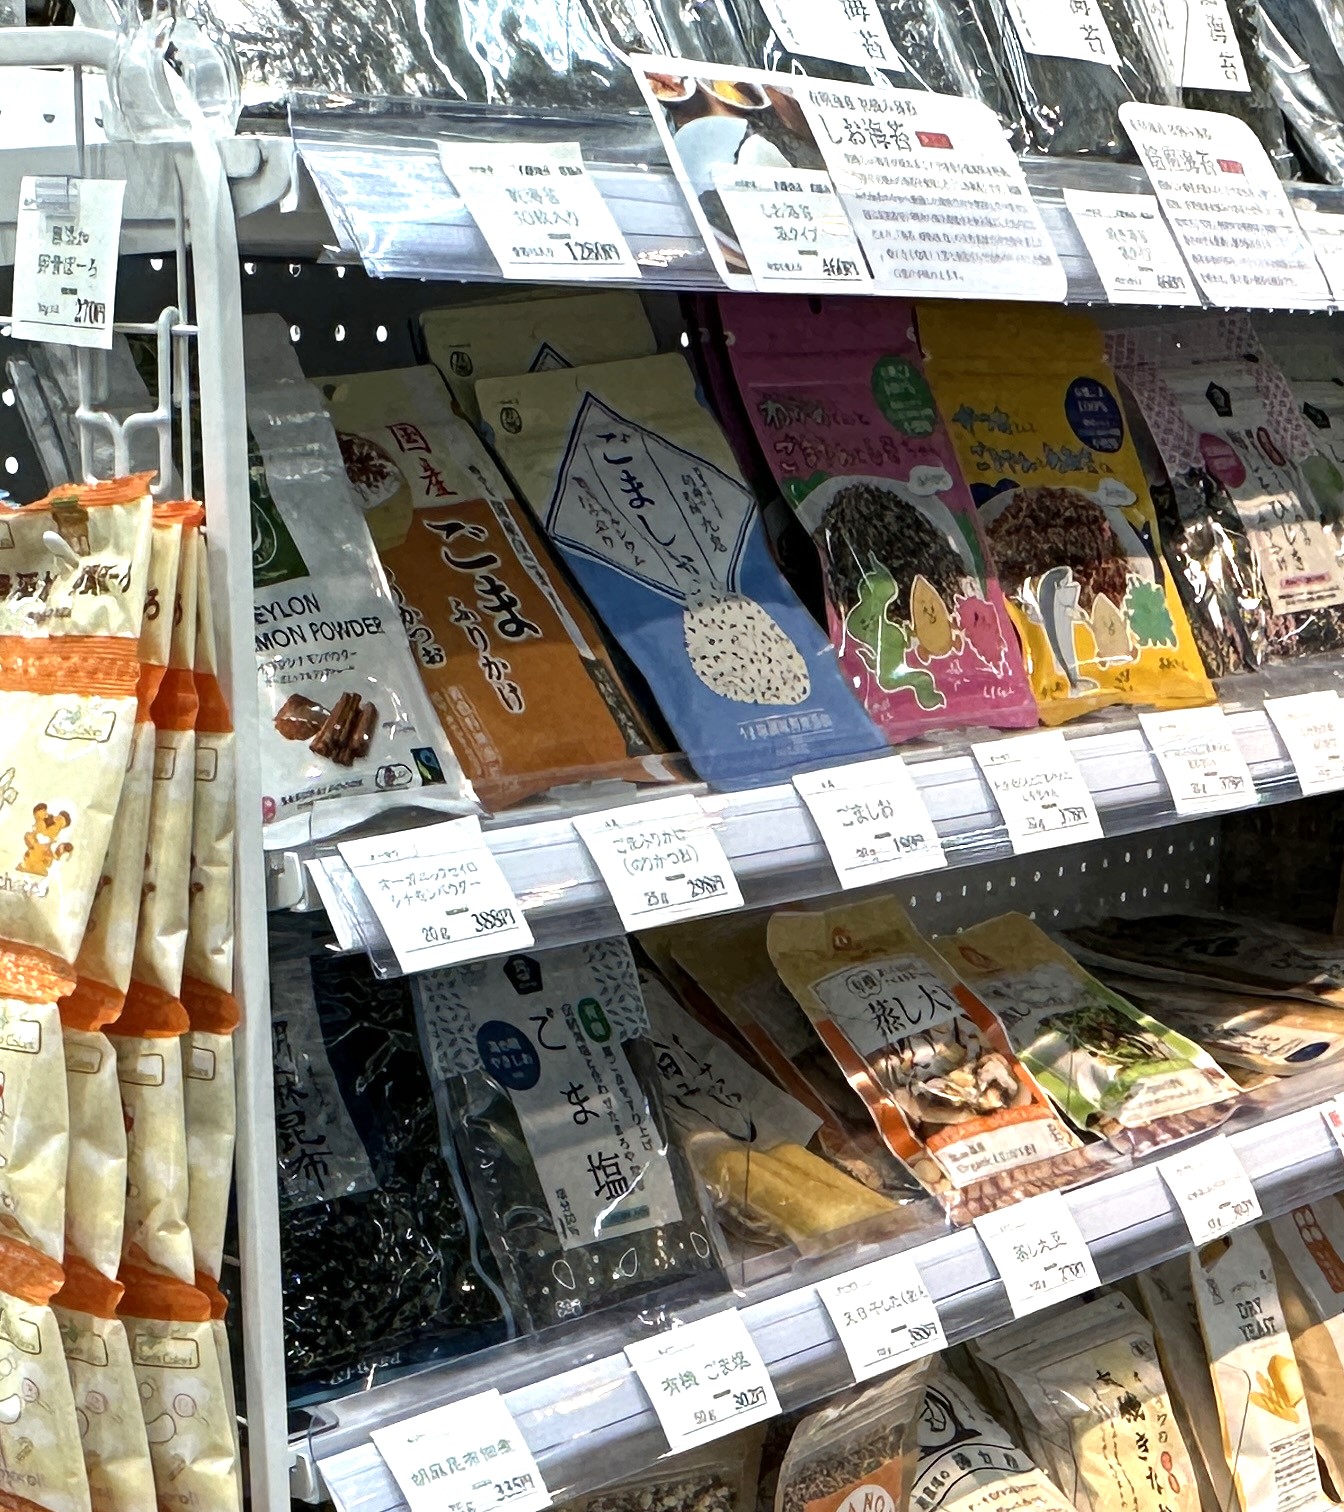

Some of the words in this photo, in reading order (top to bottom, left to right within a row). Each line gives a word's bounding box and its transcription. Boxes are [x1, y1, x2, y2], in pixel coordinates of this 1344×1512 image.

[423, 518, 545, 644] ごま
[309, 616, 385, 642] POWDER
[447, 595, 527, 716] ふりかけ
[868, 983, 958, 1037] 蒸し大
[1238, 1297, 1263, 1319] DRY
